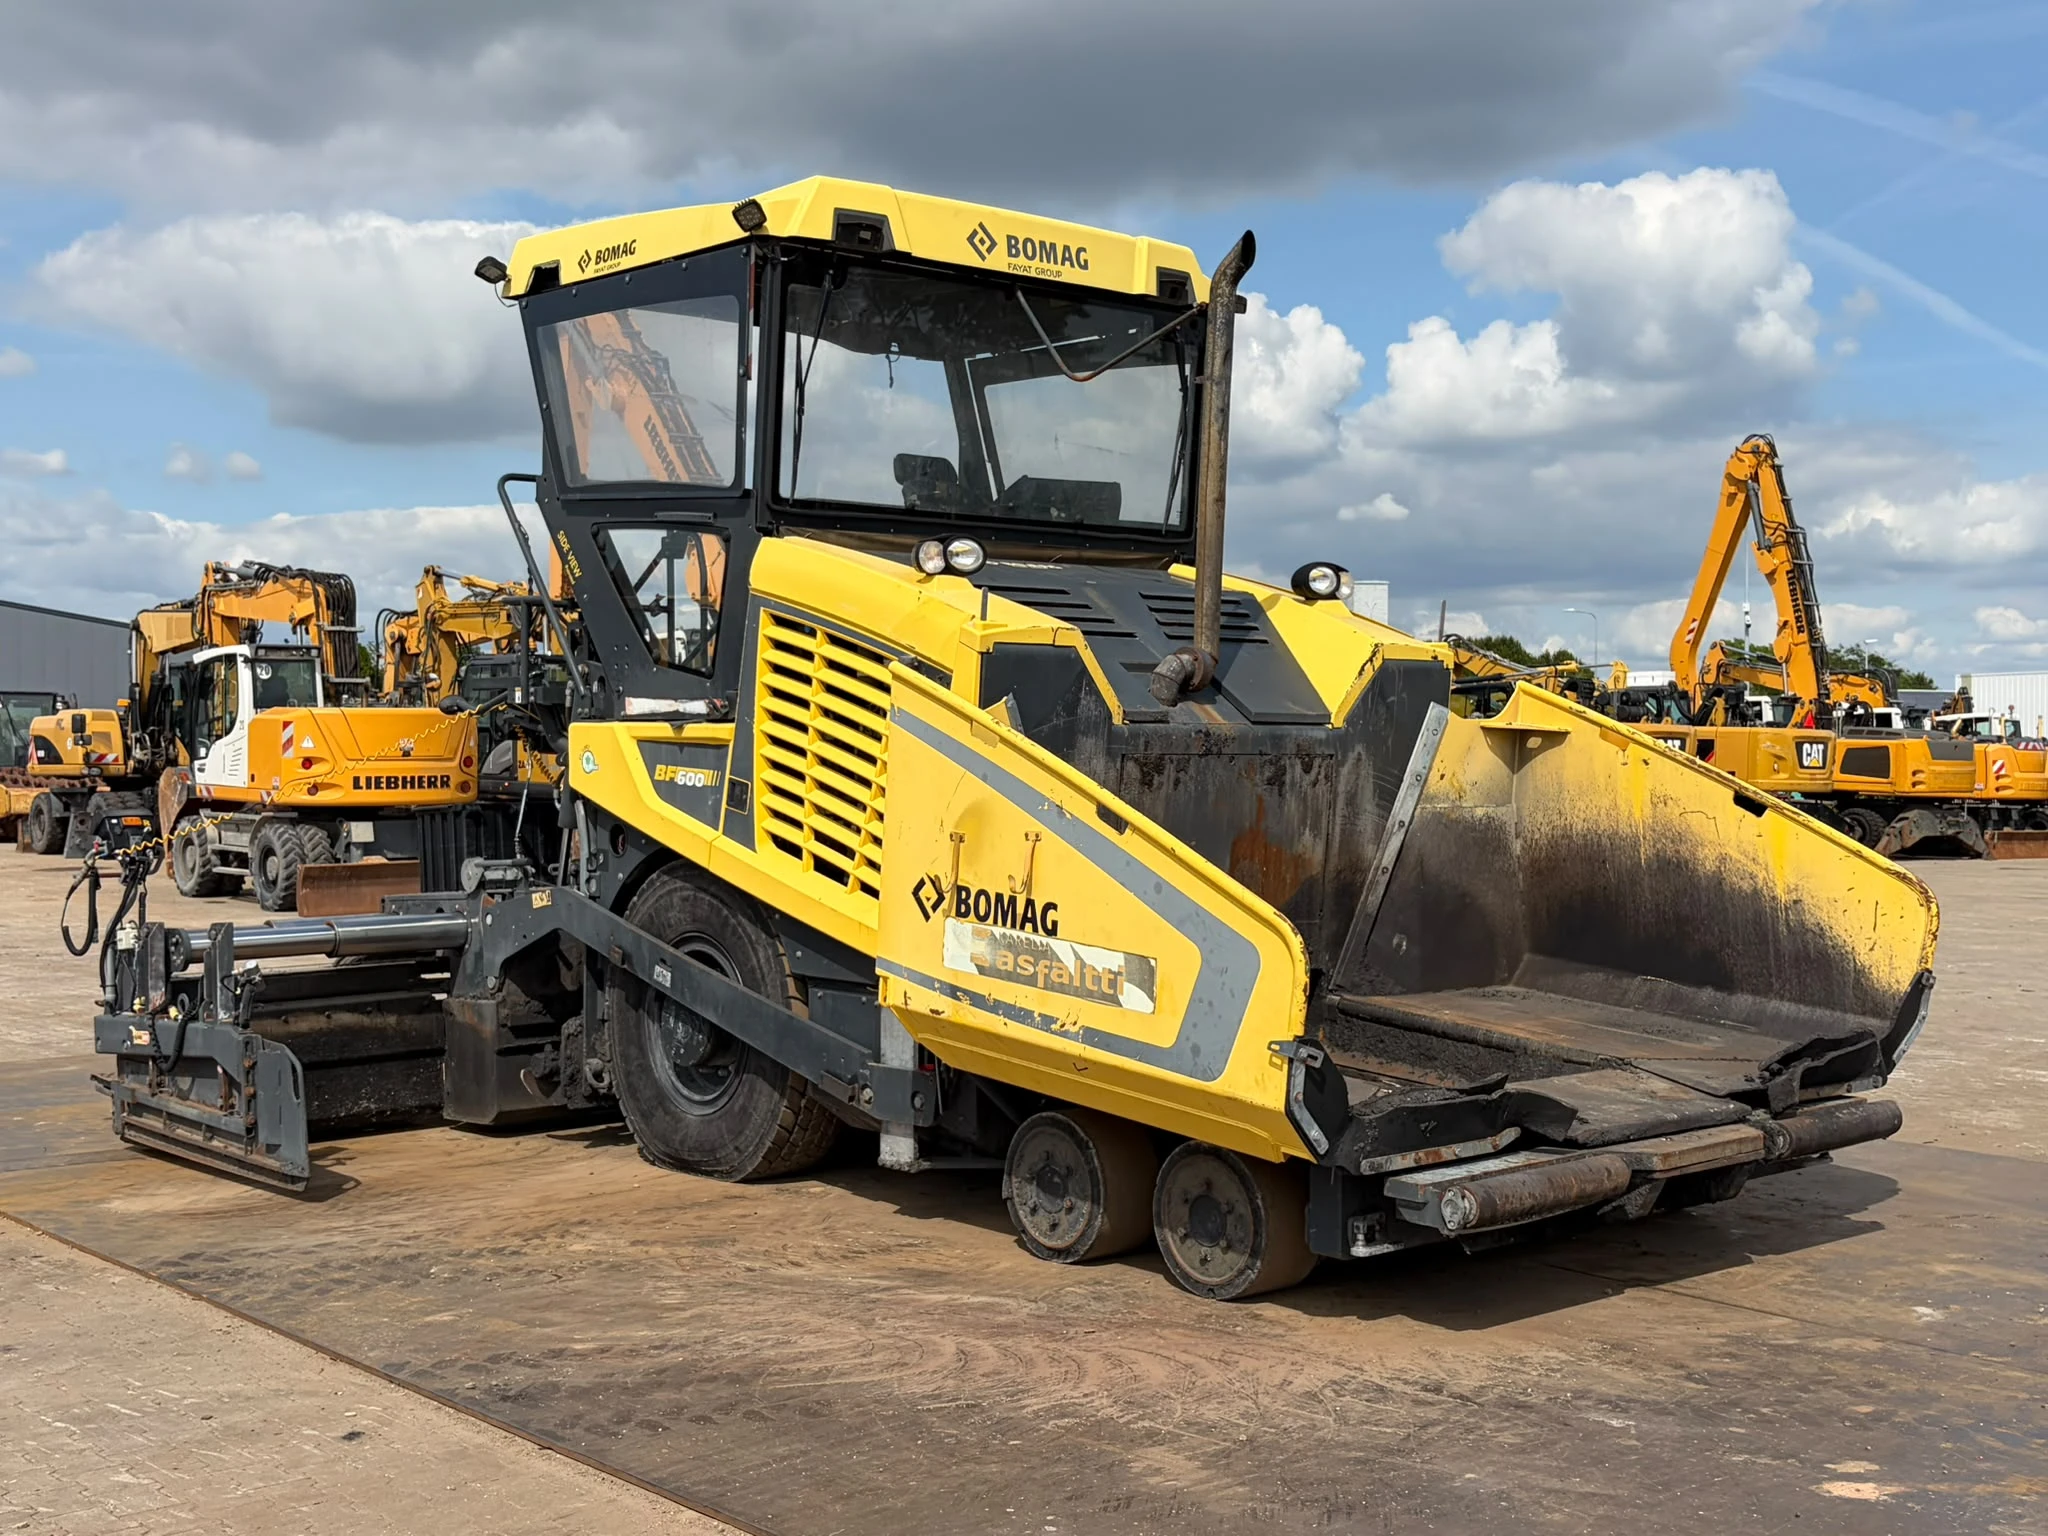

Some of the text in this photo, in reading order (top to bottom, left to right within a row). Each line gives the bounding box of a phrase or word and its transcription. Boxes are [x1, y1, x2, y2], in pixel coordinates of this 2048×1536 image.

[595, 239, 637, 266] BOMAG
[1006, 234, 1089, 270] BOMAG
[1008, 263, 1062, 279] FAYAT GROUP
[557, 530, 571, 553] SIDE
[567, 550, 583, 578] VIEW
[1785, 568, 1806, 636] LIEBHERR
[1802, 743, 1824, 768] CAT
[352, 774, 451, 790] LIEBHERR
[955, 885, 1058, 936] BOMAG
[996, 950, 1125, 996] asfaltti
